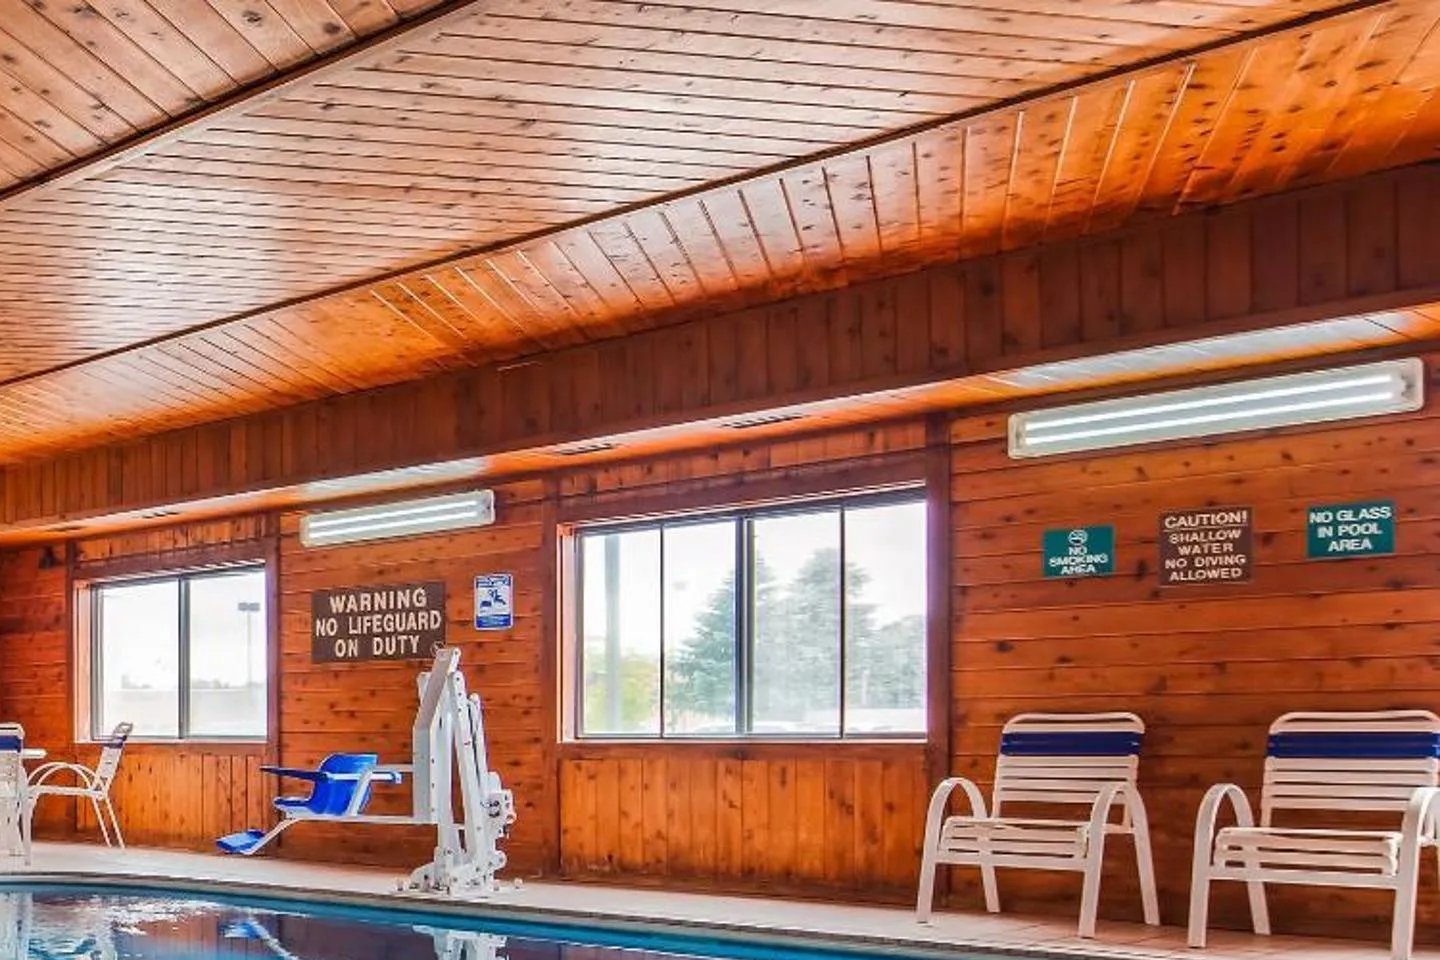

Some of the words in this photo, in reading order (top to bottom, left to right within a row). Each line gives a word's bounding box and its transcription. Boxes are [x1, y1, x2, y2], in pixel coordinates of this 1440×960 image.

[1164, 510, 1247, 529] CAUTION!
[1309, 511, 1333, 523] NO
[1336, 506, 1392, 521] GLASS
[1169, 529, 1241, 544] SHALLOW
[1317, 525, 1333, 538] IN
[1338, 522, 1382, 536] POOL
[1068, 545, 1088, 556] NO
[1178, 543, 1233, 556] WATER
[1328, 538, 1372, 552] AREA
[1049, 553, 1108, 567] SMOKING
[1165, 558, 1188, 569] NO
[1194, 554, 1246, 567] DIVING
[1061, 564, 1096, 575] AREA
[1170, 567, 1242, 581] ALLOWED
[329, 587, 427, 613] WARNING
[316, 618, 338, 637] NO
[349, 610, 441, 635] LIFEGUARD
[335, 639, 359, 657] ON
[372, 635, 420, 656] DUTY
